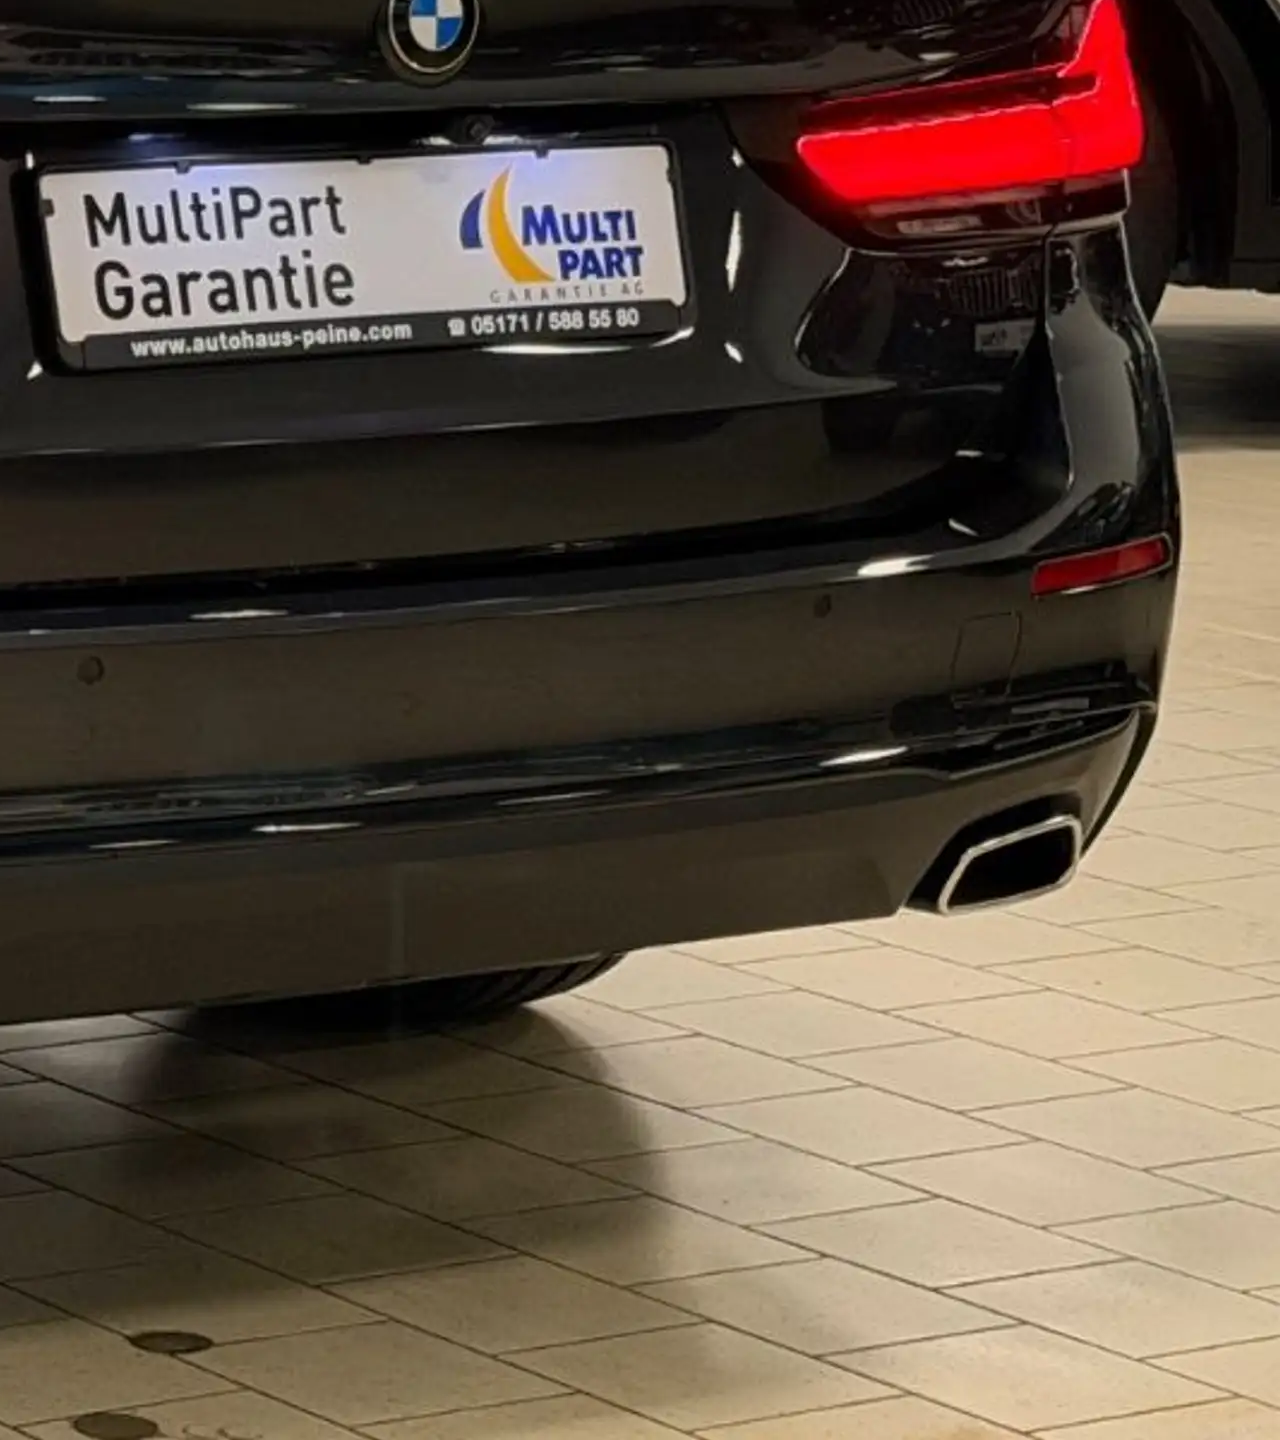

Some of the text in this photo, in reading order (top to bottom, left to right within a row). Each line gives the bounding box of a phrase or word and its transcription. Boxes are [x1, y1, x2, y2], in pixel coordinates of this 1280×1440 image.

[83, 185, 346, 247] MultiPart
[521, 205, 636, 246] MULTI
[557, 246, 644, 281] PART
[94, 250, 355, 320] Garantie
[490, 282, 644, 304] GARANTIE AG
[130, 322, 413, 358] www.autohaus-peine.com
[471, 312, 529, 336] 05171
